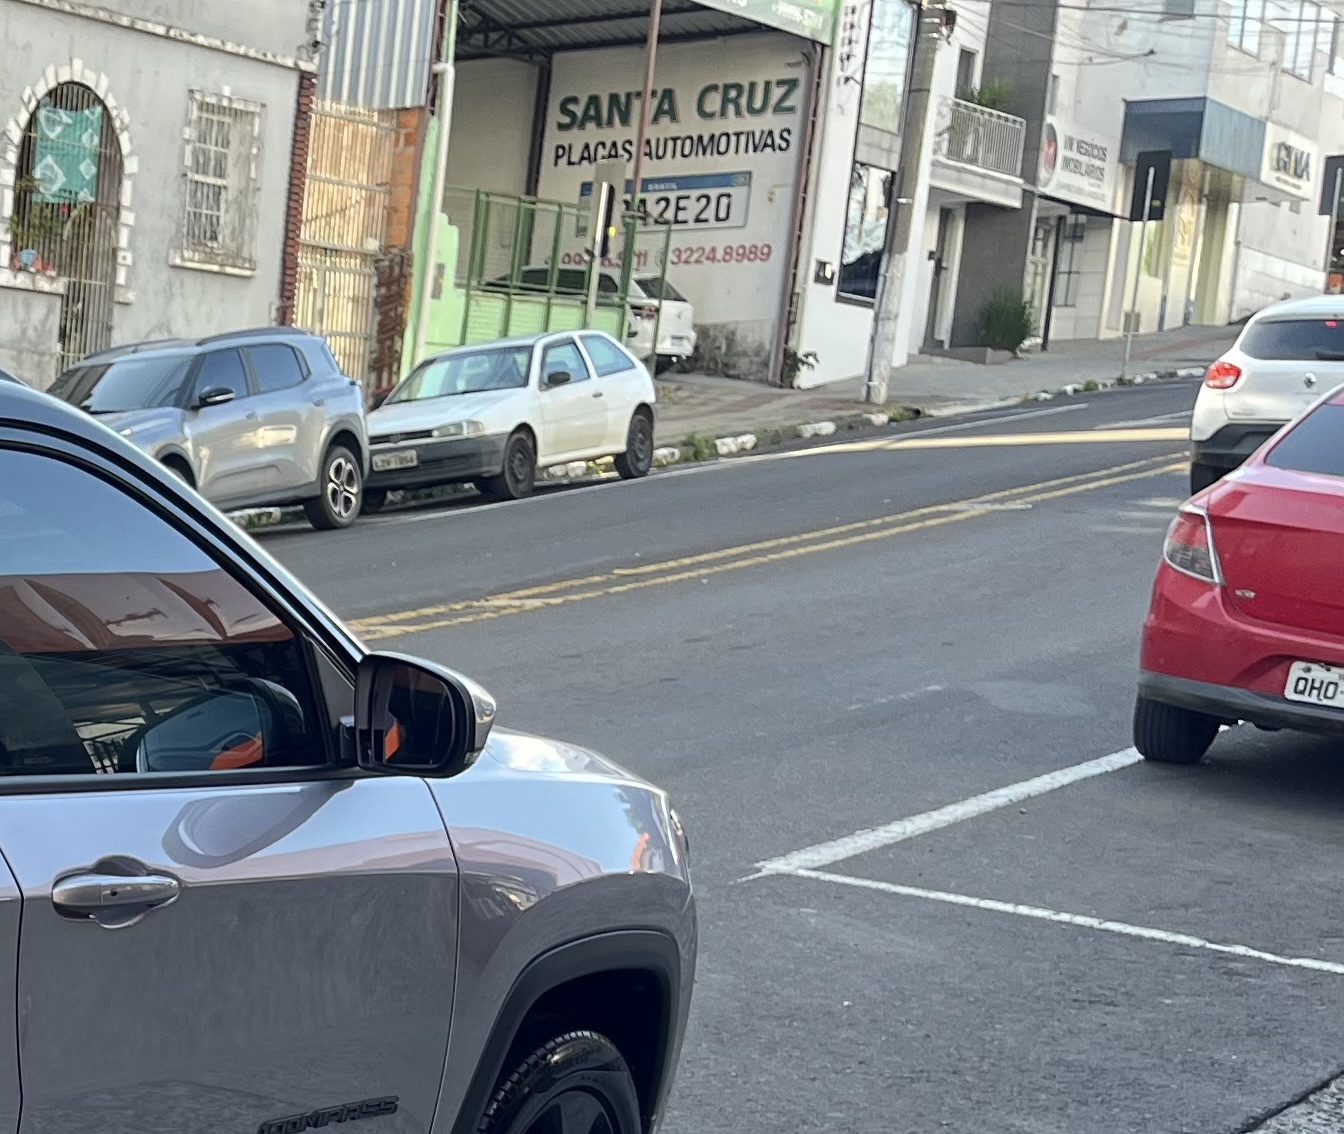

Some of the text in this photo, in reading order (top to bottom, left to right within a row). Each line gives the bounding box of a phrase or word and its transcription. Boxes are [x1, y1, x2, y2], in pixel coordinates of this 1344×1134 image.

[696, 77, 800, 120] CRUZ
[553, 127, 793, 168] PLACAS AUTOMOTIVAS
[671, 244, 772, 265] 3224.8989
